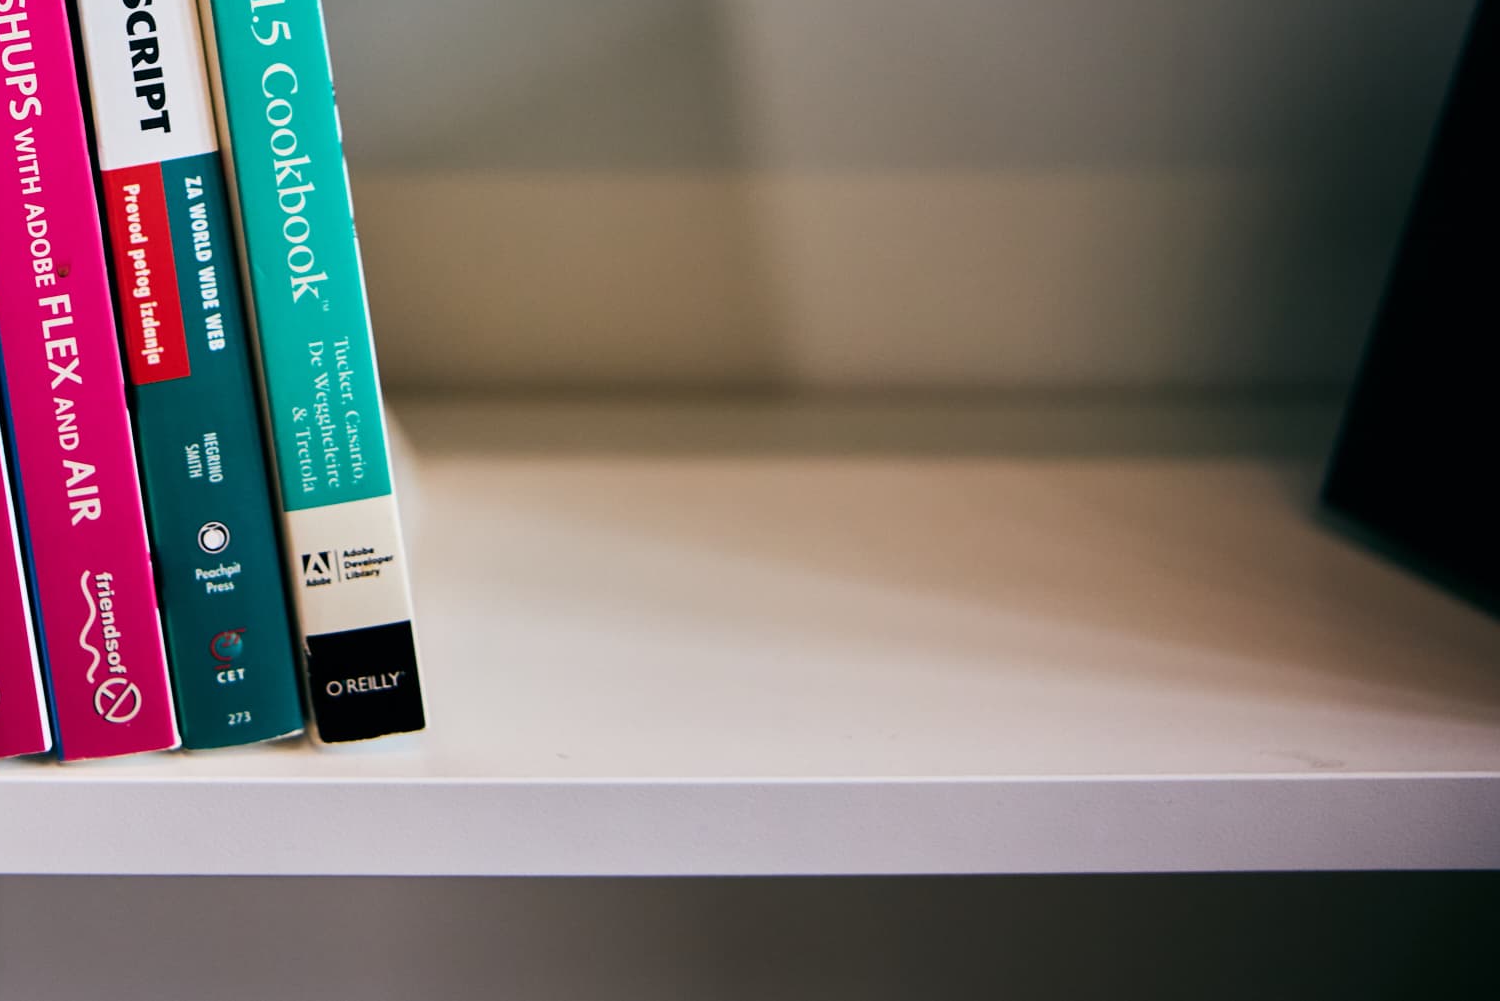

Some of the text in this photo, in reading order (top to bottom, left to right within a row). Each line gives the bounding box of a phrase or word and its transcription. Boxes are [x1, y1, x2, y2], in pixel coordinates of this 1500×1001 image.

[13, 127, 43, 195] WITH
[23, 202, 56, 288] ADOBE
[122, 183, 164, 365] Prevod petog izdanja
[184, 175, 226, 352] ZA WORLD WIDE WEB
[38, 293, 83, 390] FLEX
[308, 340, 324, 366] De
[53, 396, 80, 451] AND
[291, 406, 308, 421] &
[185, 443, 203, 479] SMITH
[203, 432, 223, 483] NEGRINO
[62, 459, 101, 526] AIR
[343, 548, 374, 558] Adobe
[344, 555, 393, 569] Developer
[195, 562, 241, 581] Peachpit
[206, 580, 234, 594] Press
[217, 667, 245, 684] CET
[228, 711, 252, 726] 273
